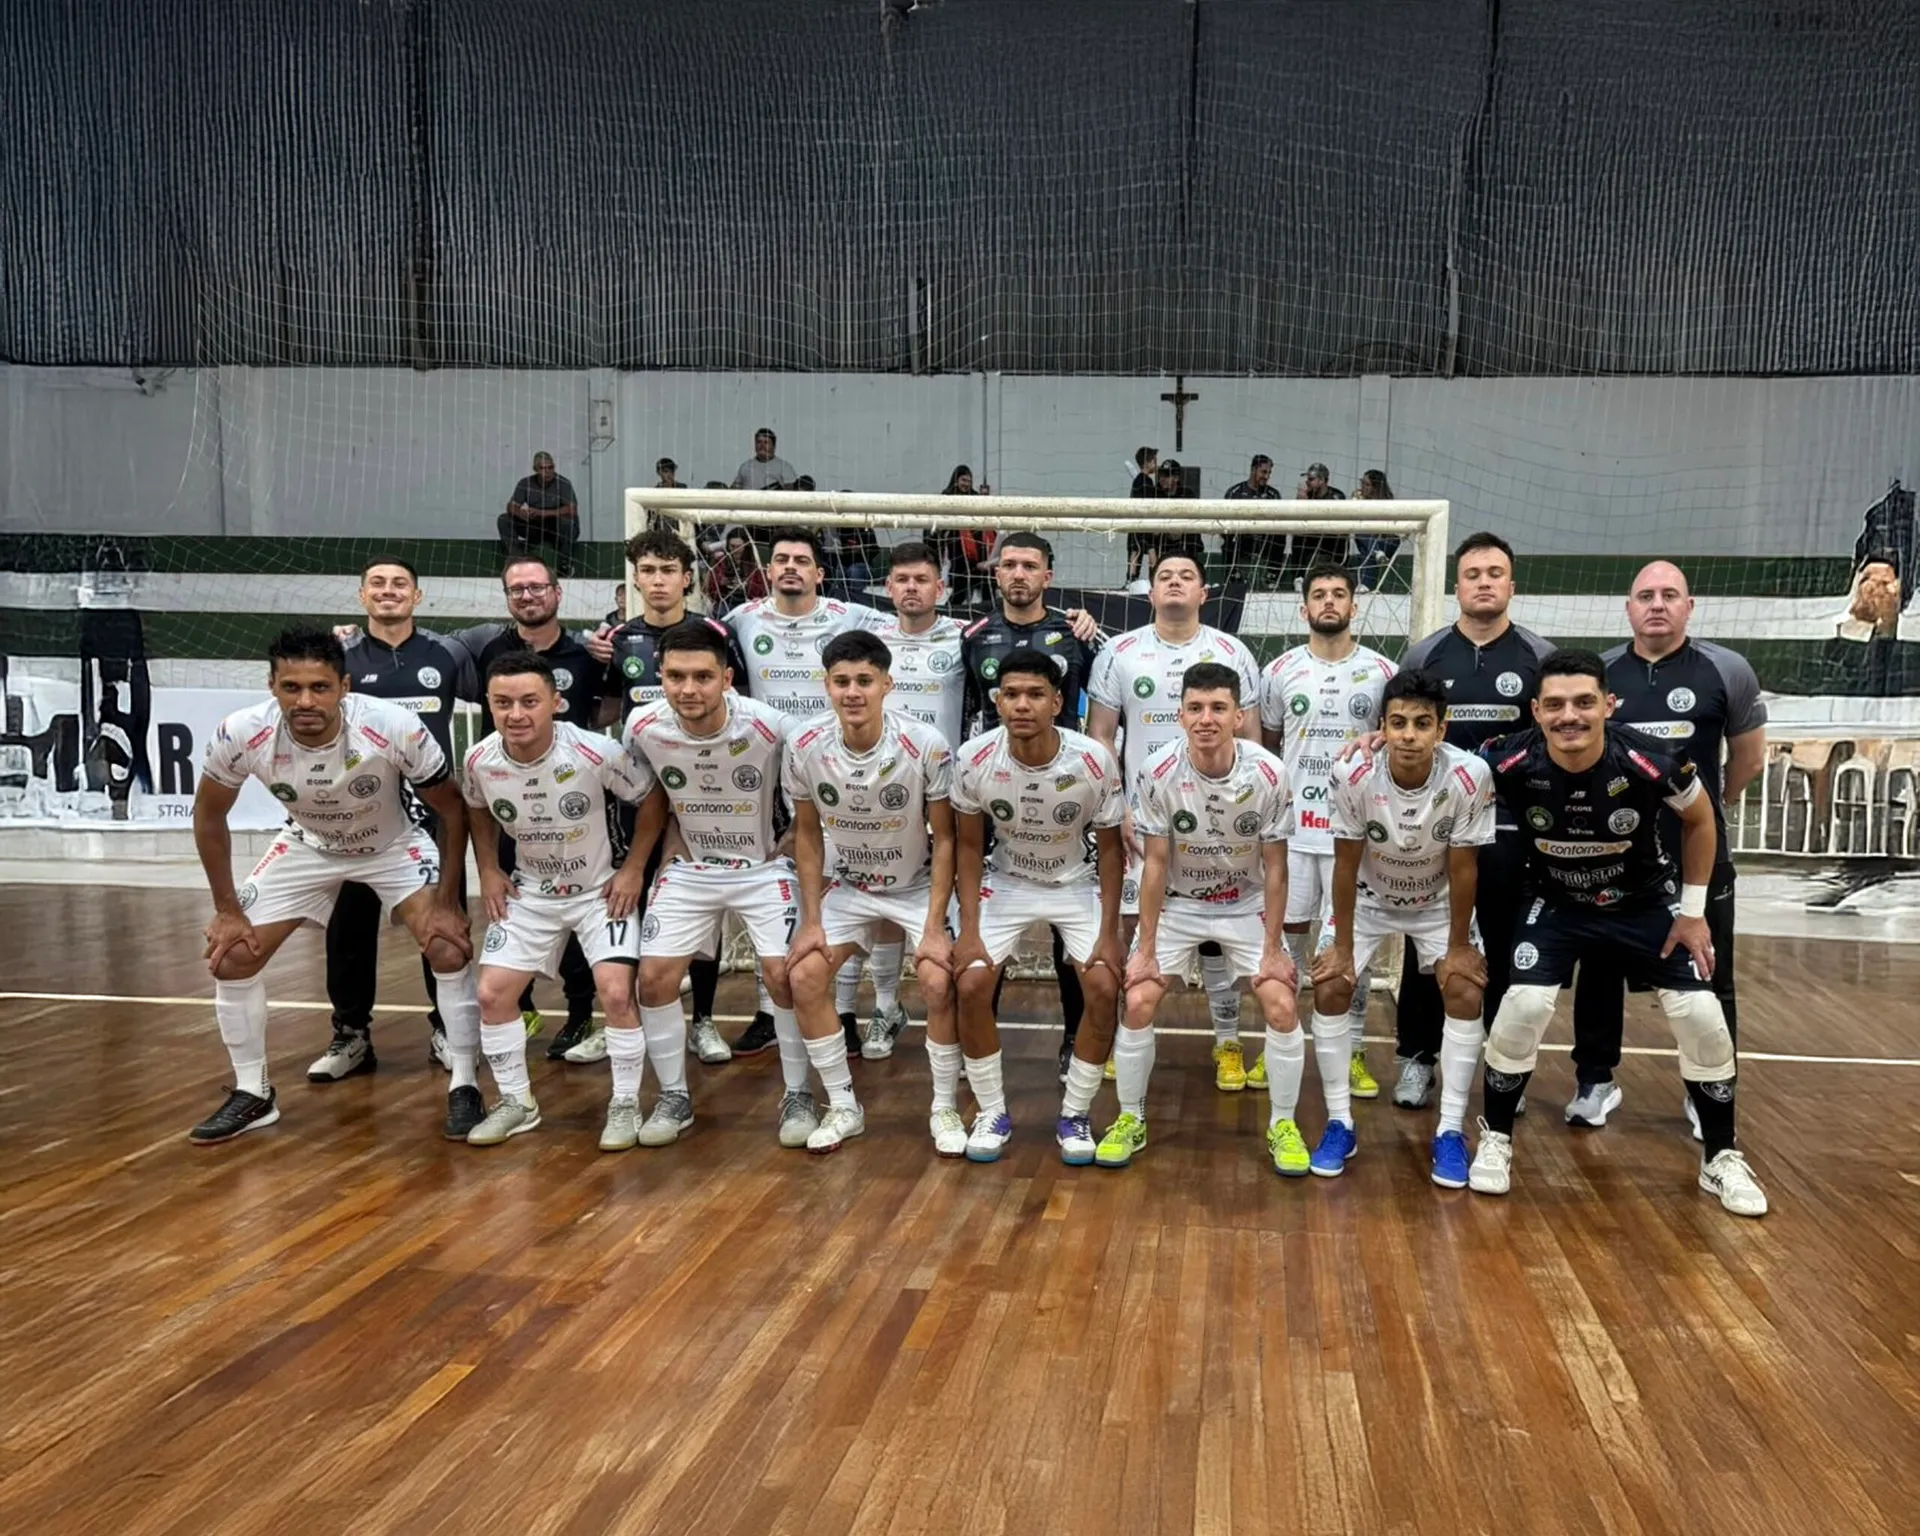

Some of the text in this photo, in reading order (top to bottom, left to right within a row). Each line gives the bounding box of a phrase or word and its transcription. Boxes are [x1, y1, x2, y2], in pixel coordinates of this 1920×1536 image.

[769, 668, 811, 679] contorno
[1453, 707, 1498, 718] contorno
[1299, 759, 1331, 770] SCHOO
[1302, 786, 1328, 800] GM
[686, 802, 733, 814] contorno
[301, 810, 354, 821] contorno
[836, 818, 881, 831] contorno
[518, 830, 564, 842] contorno
[688, 834, 755, 846] SCHOOSLON
[837, 848, 903, 861] SCHOOSLON
[1550, 845, 1604, 856] contorno
[1381, 855, 1431, 868] contorno
[605, 920, 627, 946] 17
[785, 918, 796, 945] 7
